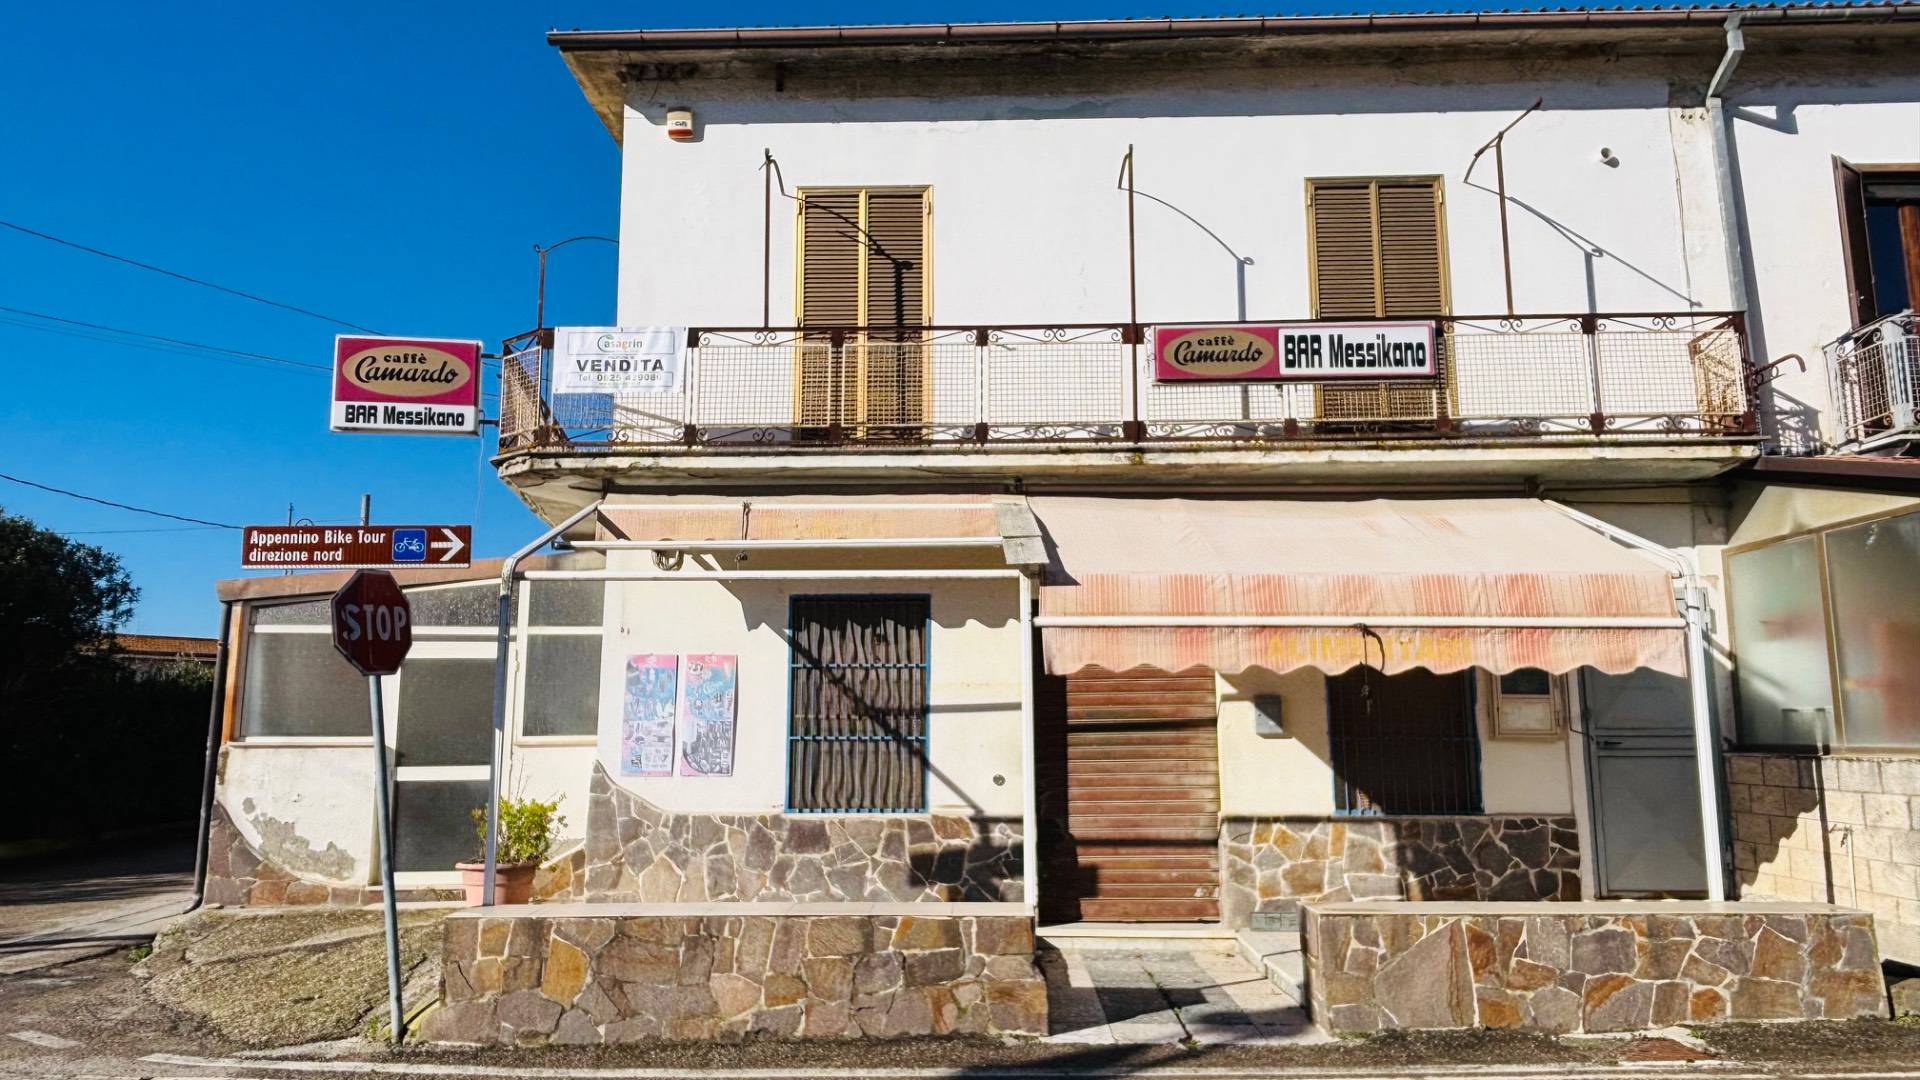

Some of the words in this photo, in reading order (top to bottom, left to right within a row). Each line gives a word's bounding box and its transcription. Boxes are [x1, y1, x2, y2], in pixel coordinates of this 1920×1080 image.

[1197, 336, 1235, 346] caffè
[1284, 335, 1323, 368] BAR
[1328, 333, 1426, 368] Messikano
[384, 353, 427, 364] caffè
[1174, 341, 1263, 366] Camardo
[354, 355, 459, 384] Camardo
[576, 359, 665, 372] VENDITA
[345, 404, 378, 424] BAR
[383, 406, 465, 427] Messikano
[250, 530, 319, 547] Appennino
[324, 529, 353, 544] Bike
[357, 530, 386, 544] Tour
[249, 548, 309, 562] direzione
[313, 548, 343, 562] nord
[342, 604, 407, 641] STOP
